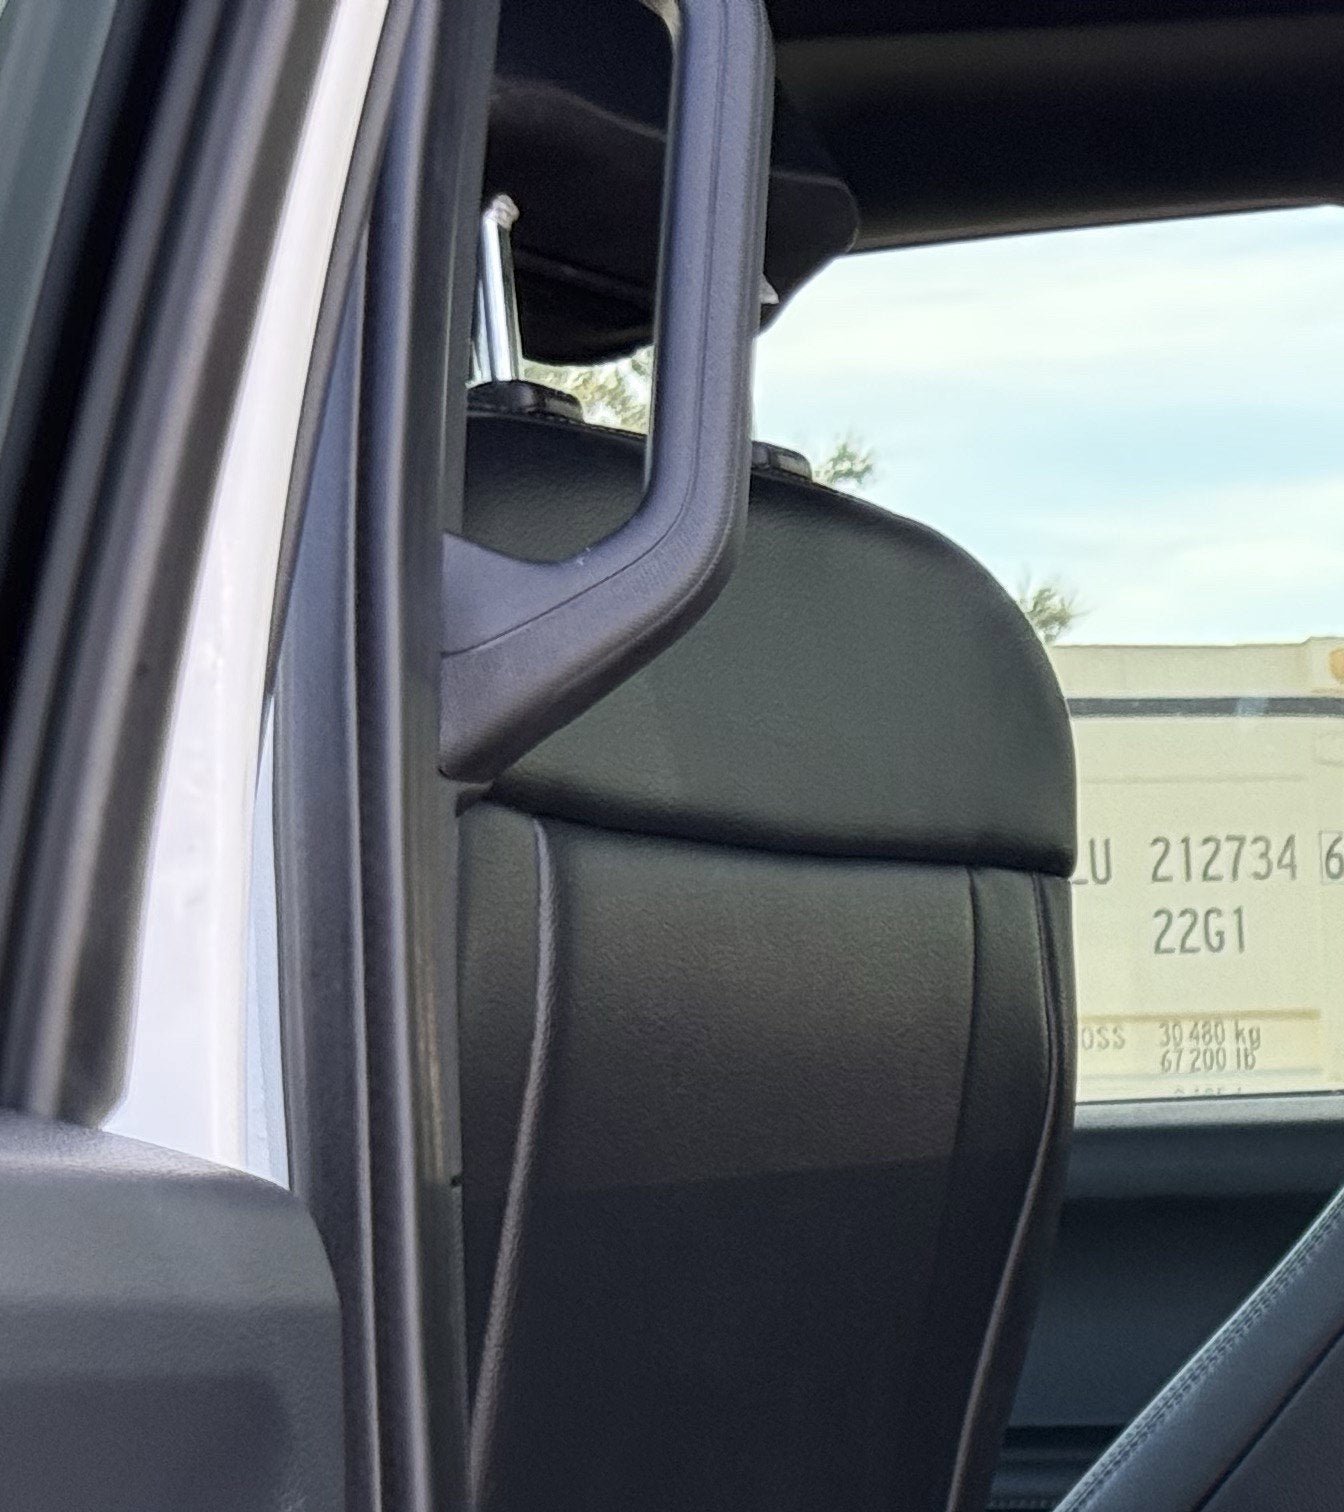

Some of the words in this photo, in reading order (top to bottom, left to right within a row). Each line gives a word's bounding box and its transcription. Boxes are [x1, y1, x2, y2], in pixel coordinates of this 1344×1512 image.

[1149, 834, 1299, 884] 212734
[1153, 905, 1246, 955] 22G1
[1235, 1017, 1261, 1050] kg
